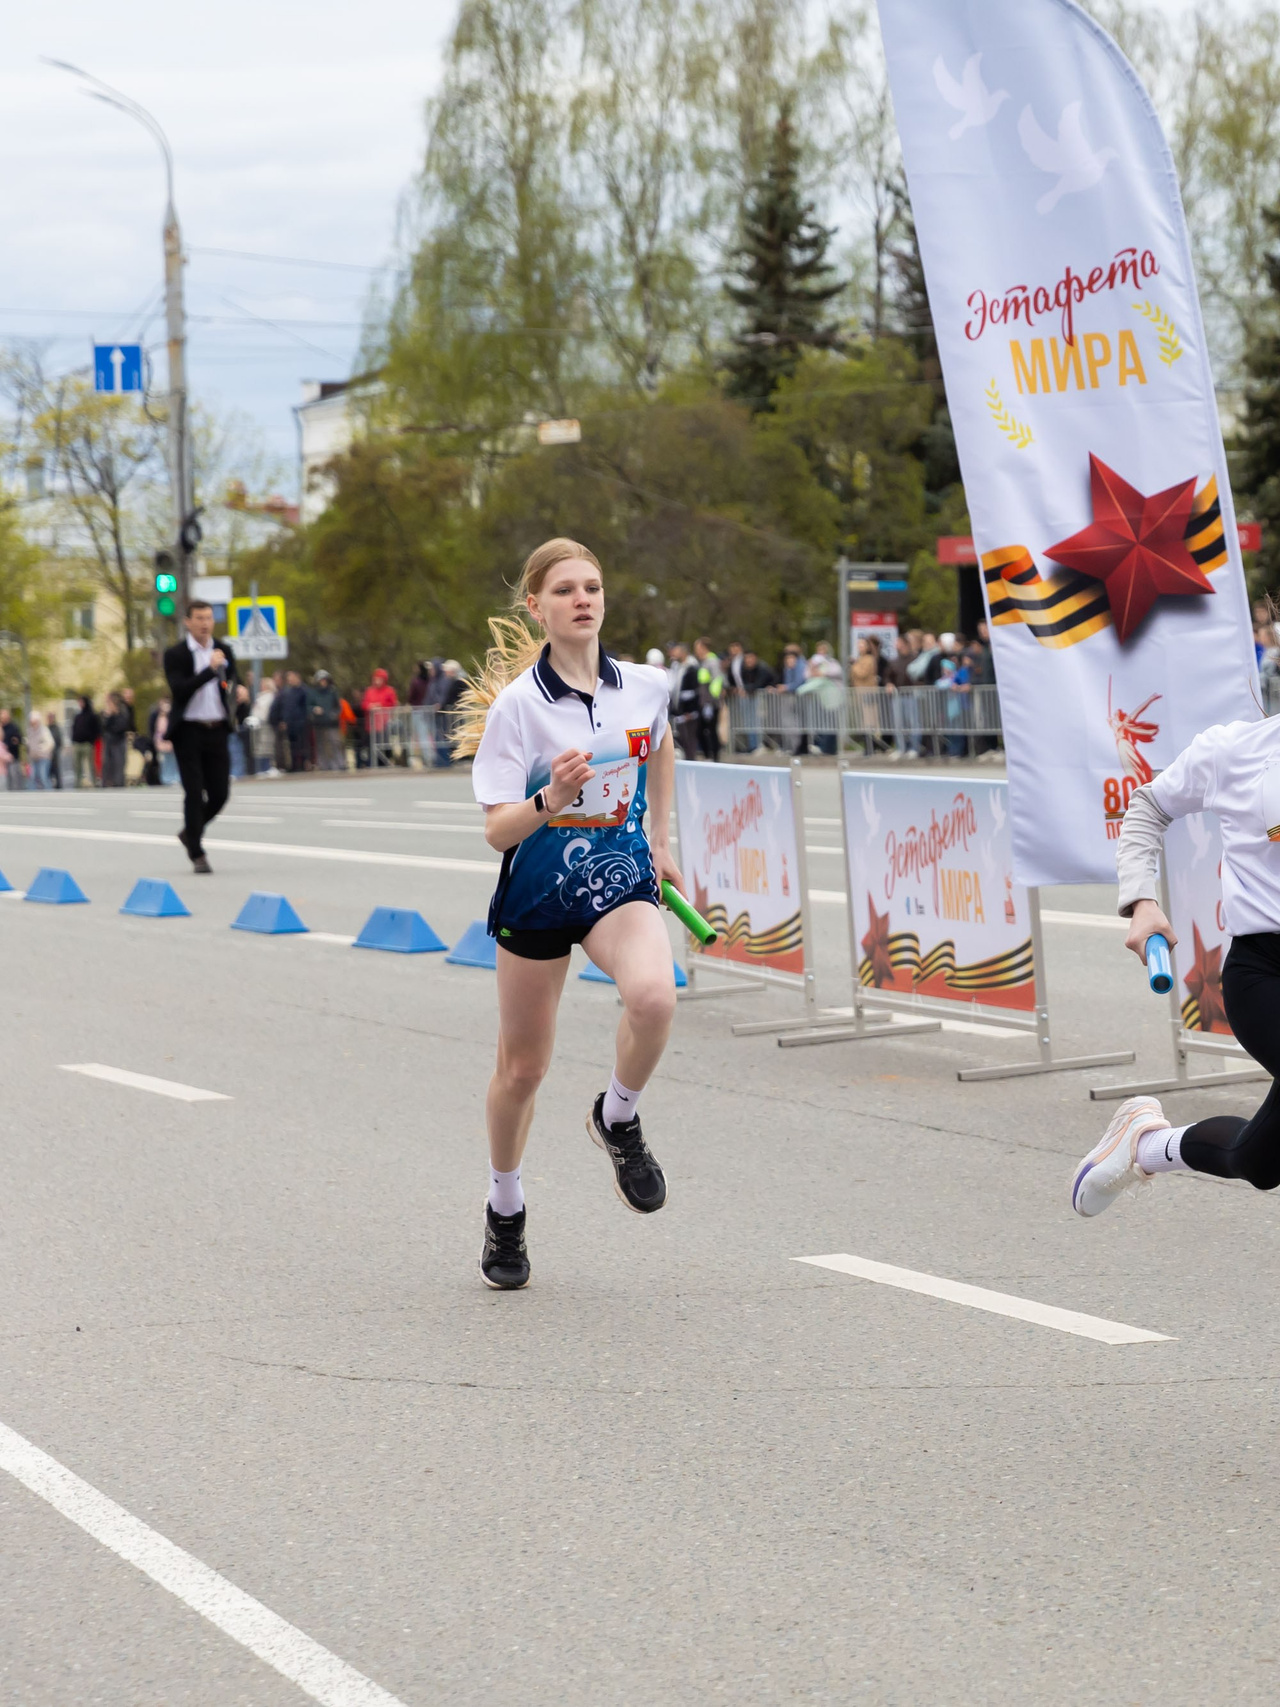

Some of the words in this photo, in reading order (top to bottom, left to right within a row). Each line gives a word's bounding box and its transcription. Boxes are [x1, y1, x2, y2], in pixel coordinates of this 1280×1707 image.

[964, 247, 1160, 347] Эстафета
[1009, 329, 1147, 395] МИРА
[572, 788, 584, 807] 3
[602, 783, 610, 798] 5
[884, 792, 977, 920] Эстафета
[940, 868, 986, 924] МИРА
